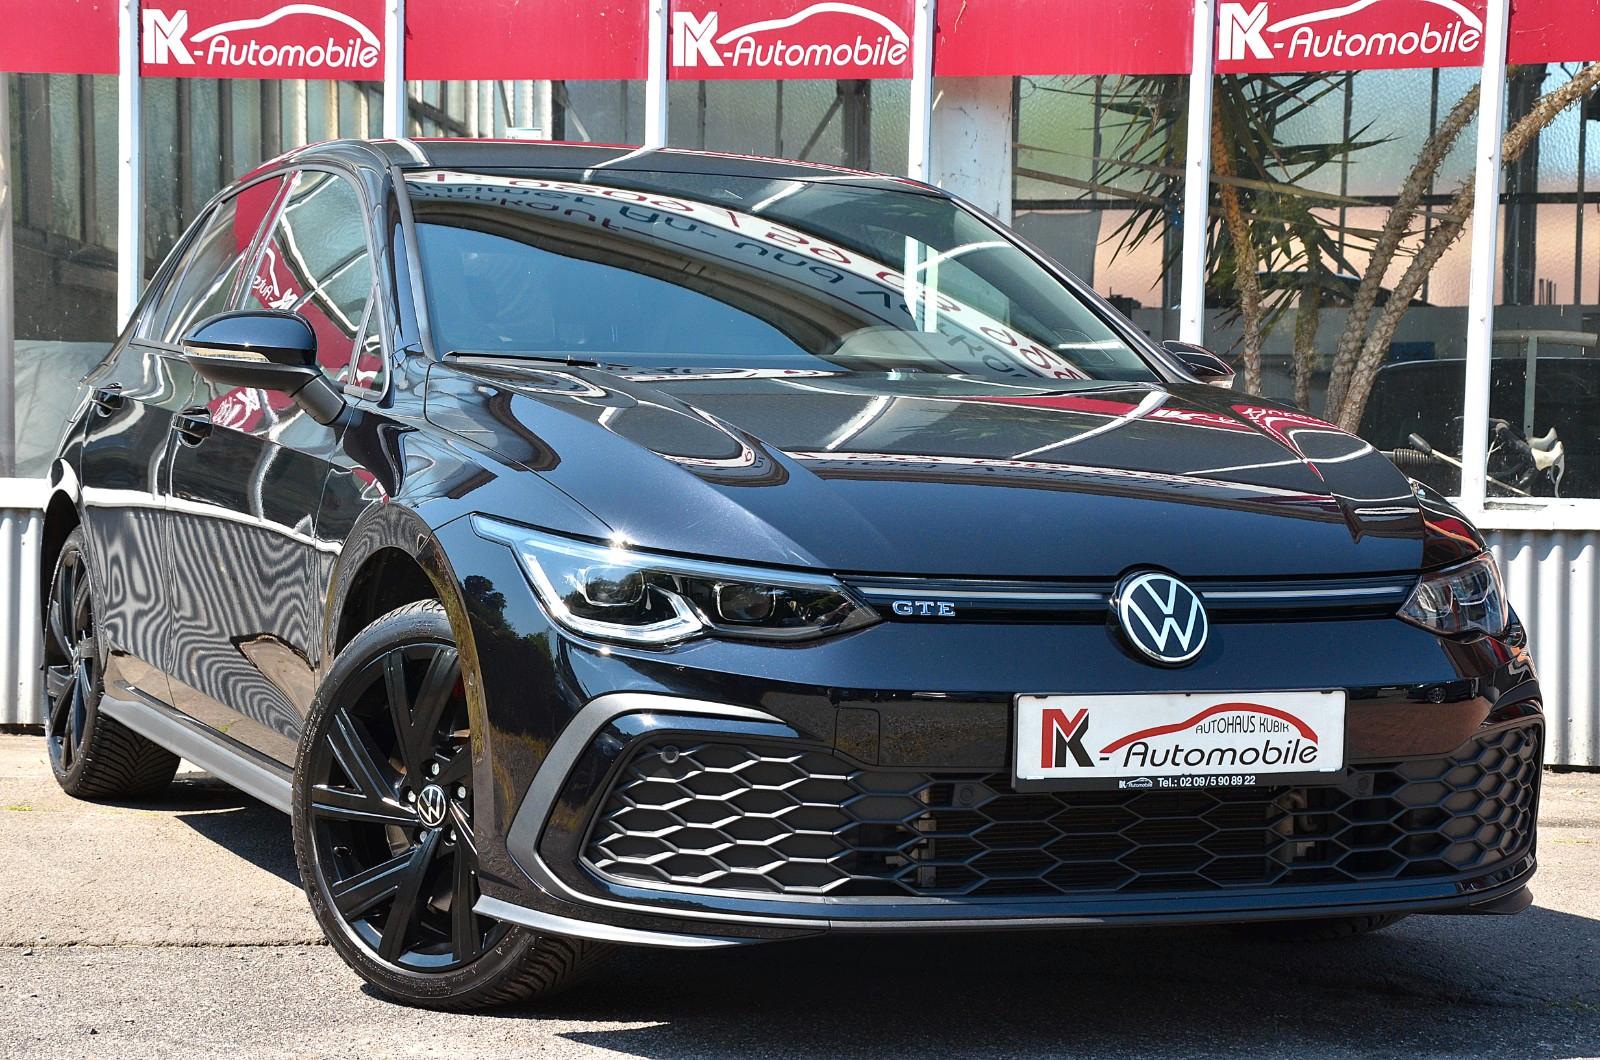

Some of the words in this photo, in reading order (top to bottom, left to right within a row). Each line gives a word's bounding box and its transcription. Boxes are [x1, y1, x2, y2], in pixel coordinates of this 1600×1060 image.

[891, 600, 956, 617] GTE
[1195, 715, 1256, 735] AUTOHAUS
[1259, 716, 1290, 733] KUBIK
[1157, 777, 1178, 788] Tel.:
[1179, 777, 1192, 787] 02
[1243, 775, 1256, 786] 22
